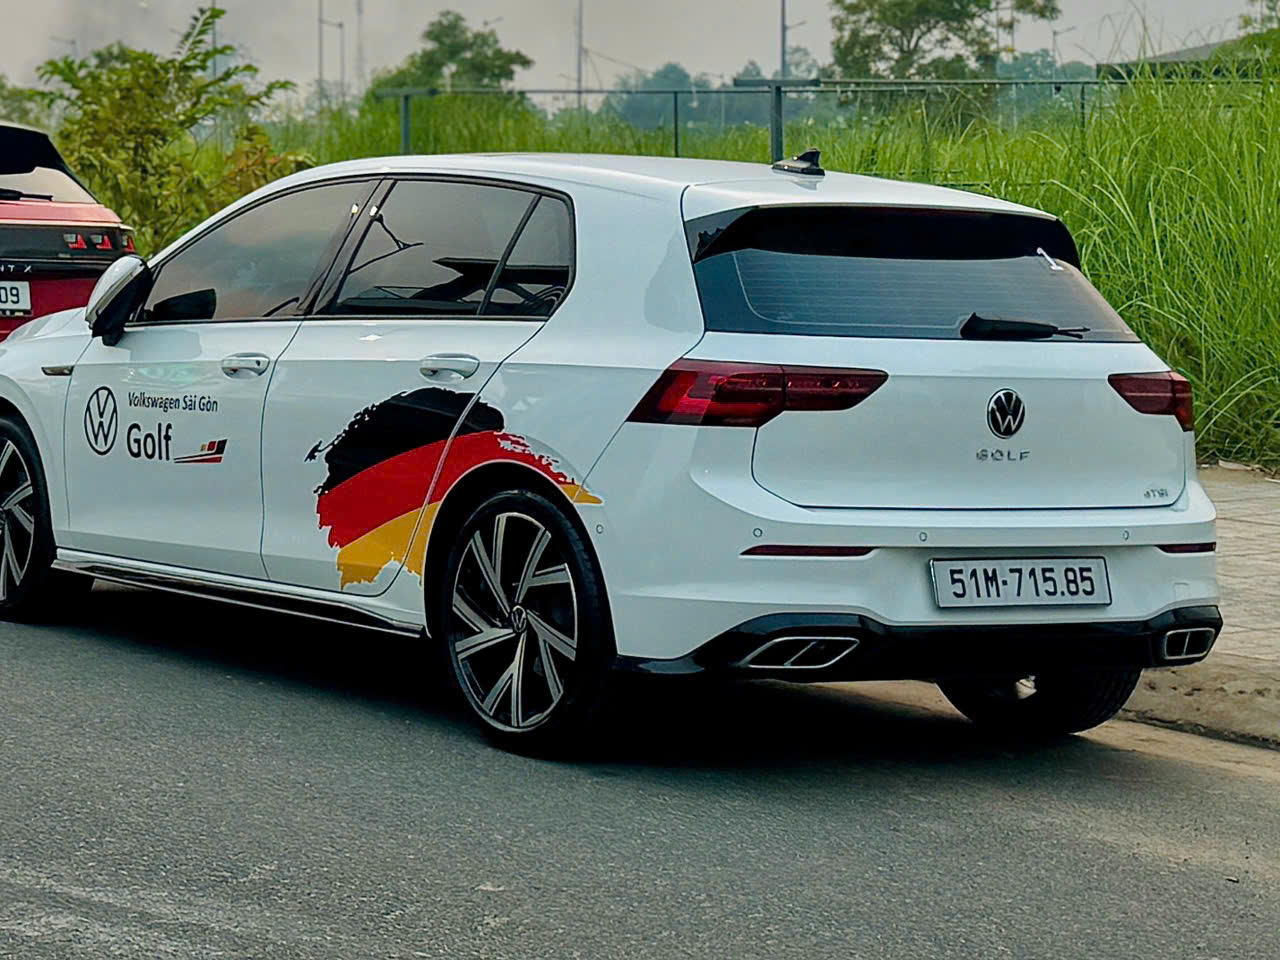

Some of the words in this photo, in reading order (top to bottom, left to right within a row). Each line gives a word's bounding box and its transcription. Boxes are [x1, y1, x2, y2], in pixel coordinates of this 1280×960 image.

[23, 265, 33, 273] X
[128, 392, 180, 413] Volkswagen
[126, 422, 173, 461] Golf
[975, 448, 1031, 462] GOLF
